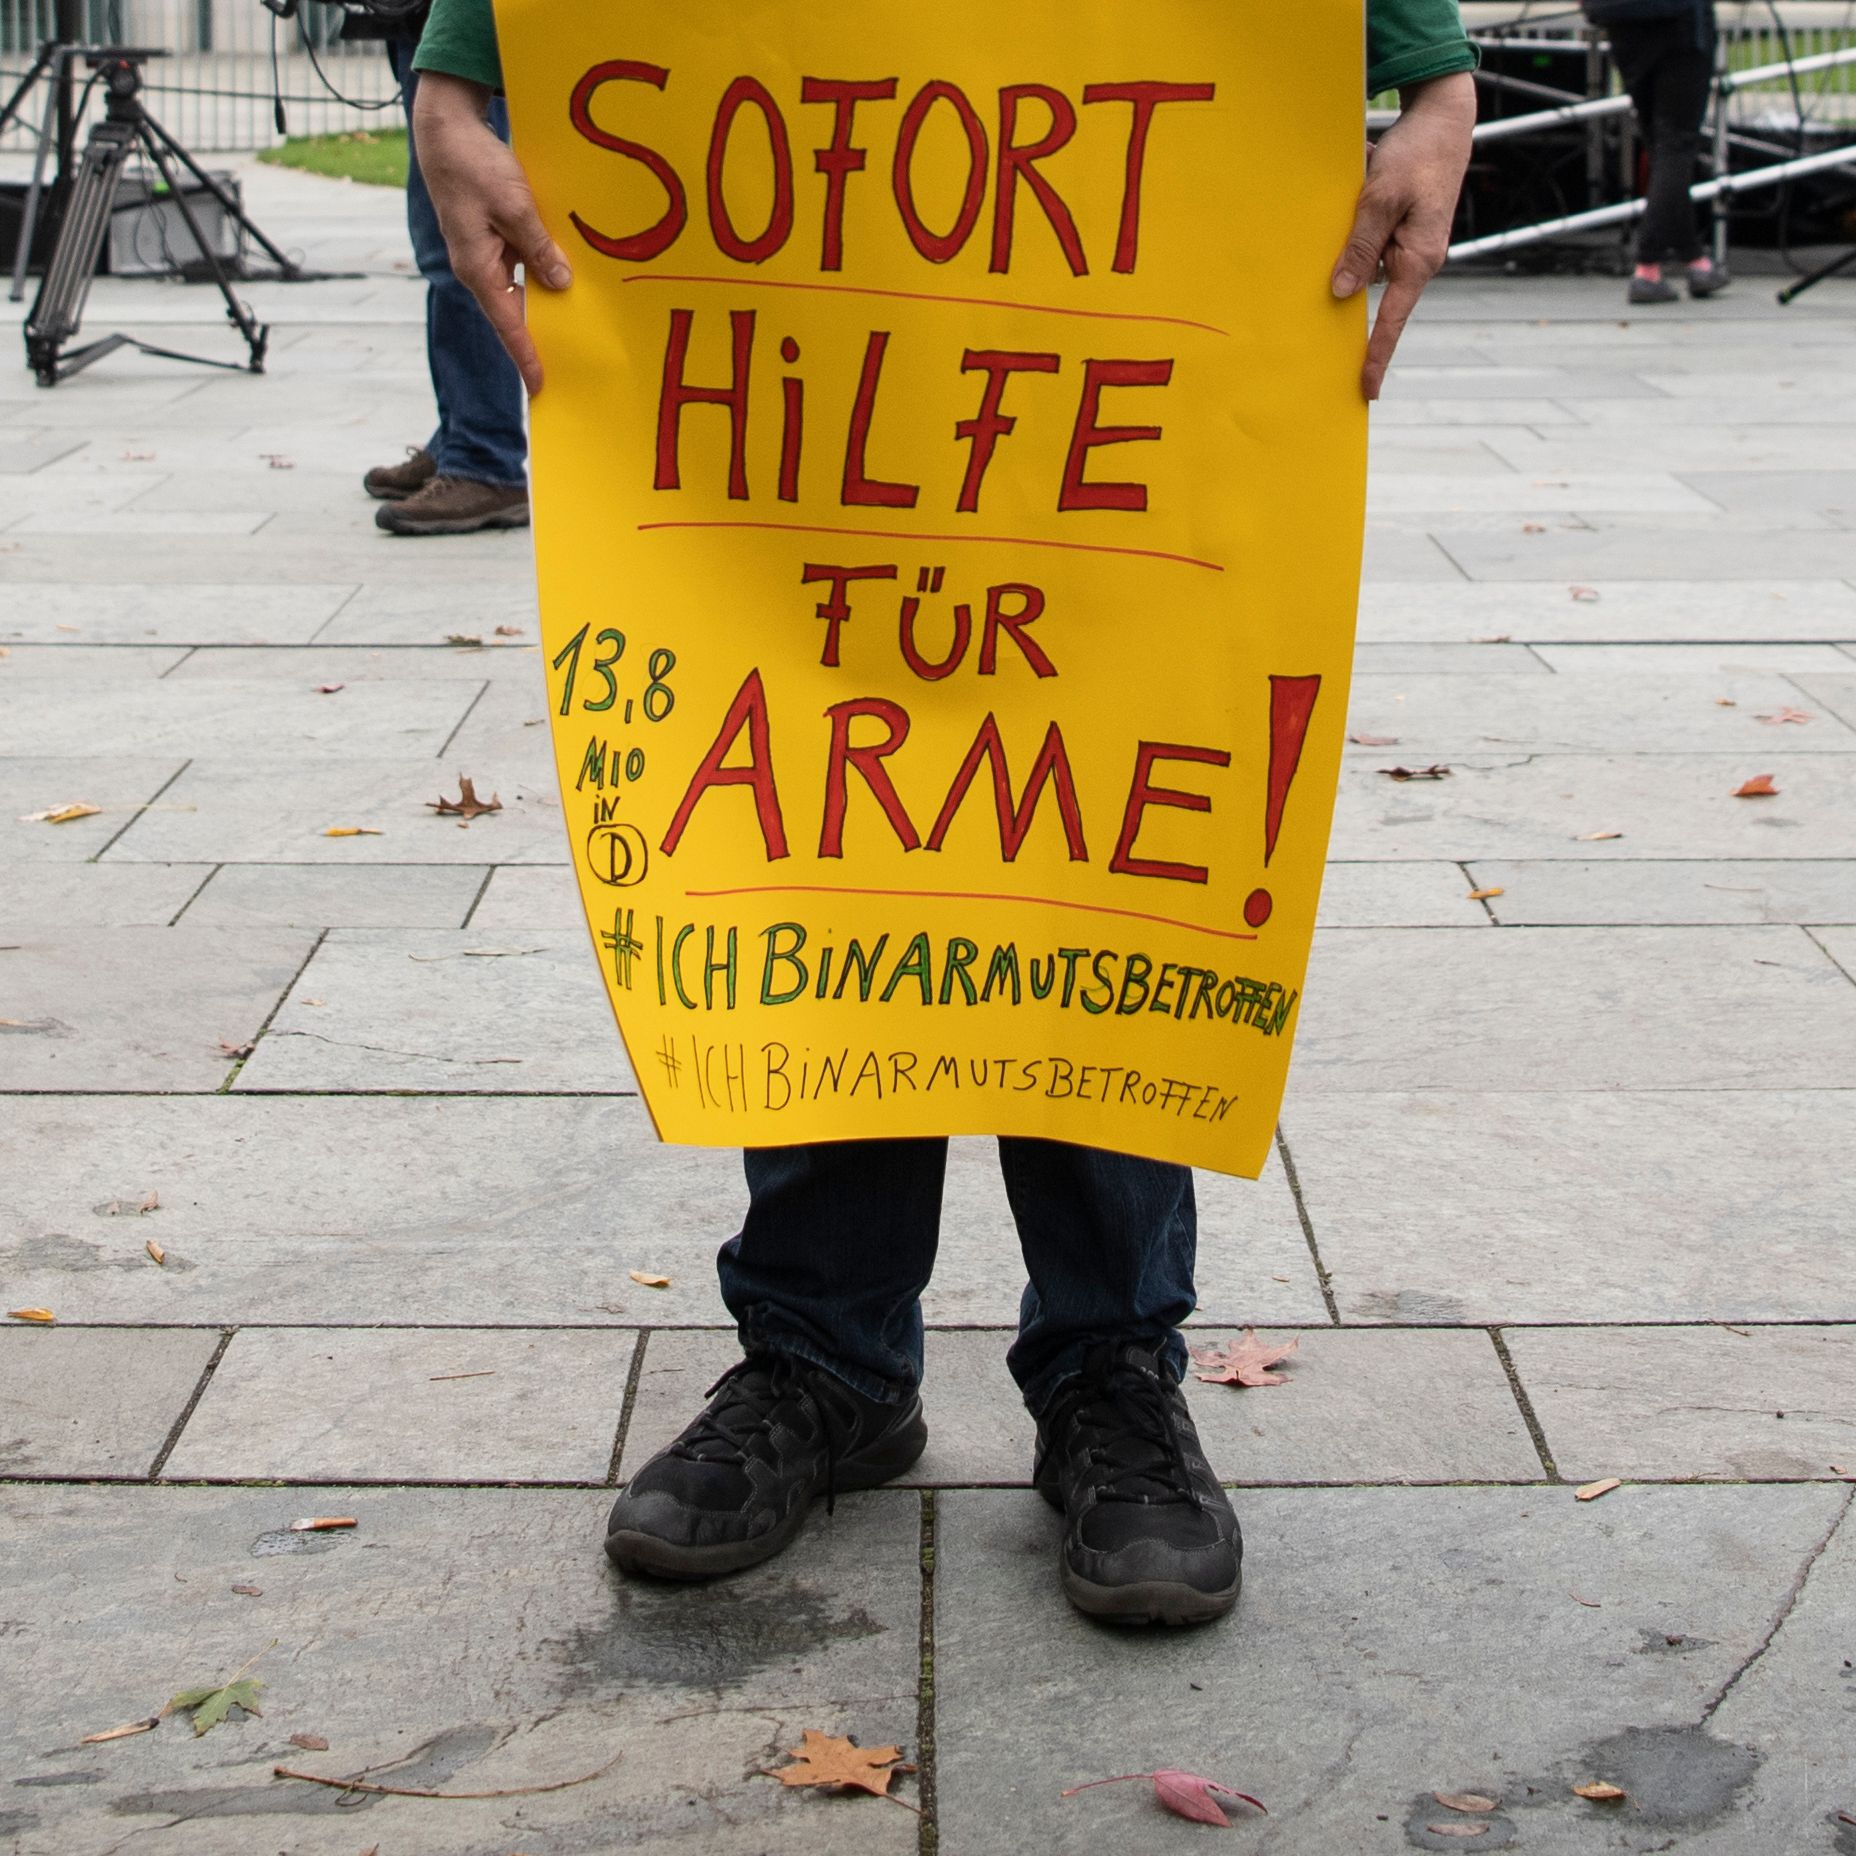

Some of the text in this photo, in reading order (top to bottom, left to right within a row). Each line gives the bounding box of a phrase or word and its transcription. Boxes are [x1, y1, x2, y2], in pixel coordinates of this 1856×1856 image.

[568, 59, 1216, 277] SOFORT
[552, 621, 677, 725] 13,8
[801, 562, 1059, 682] FÜR
[575, 735, 646, 792] MIO
[658, 667, 1323, 929] ARME!
[595, 828, 637, 885] D
